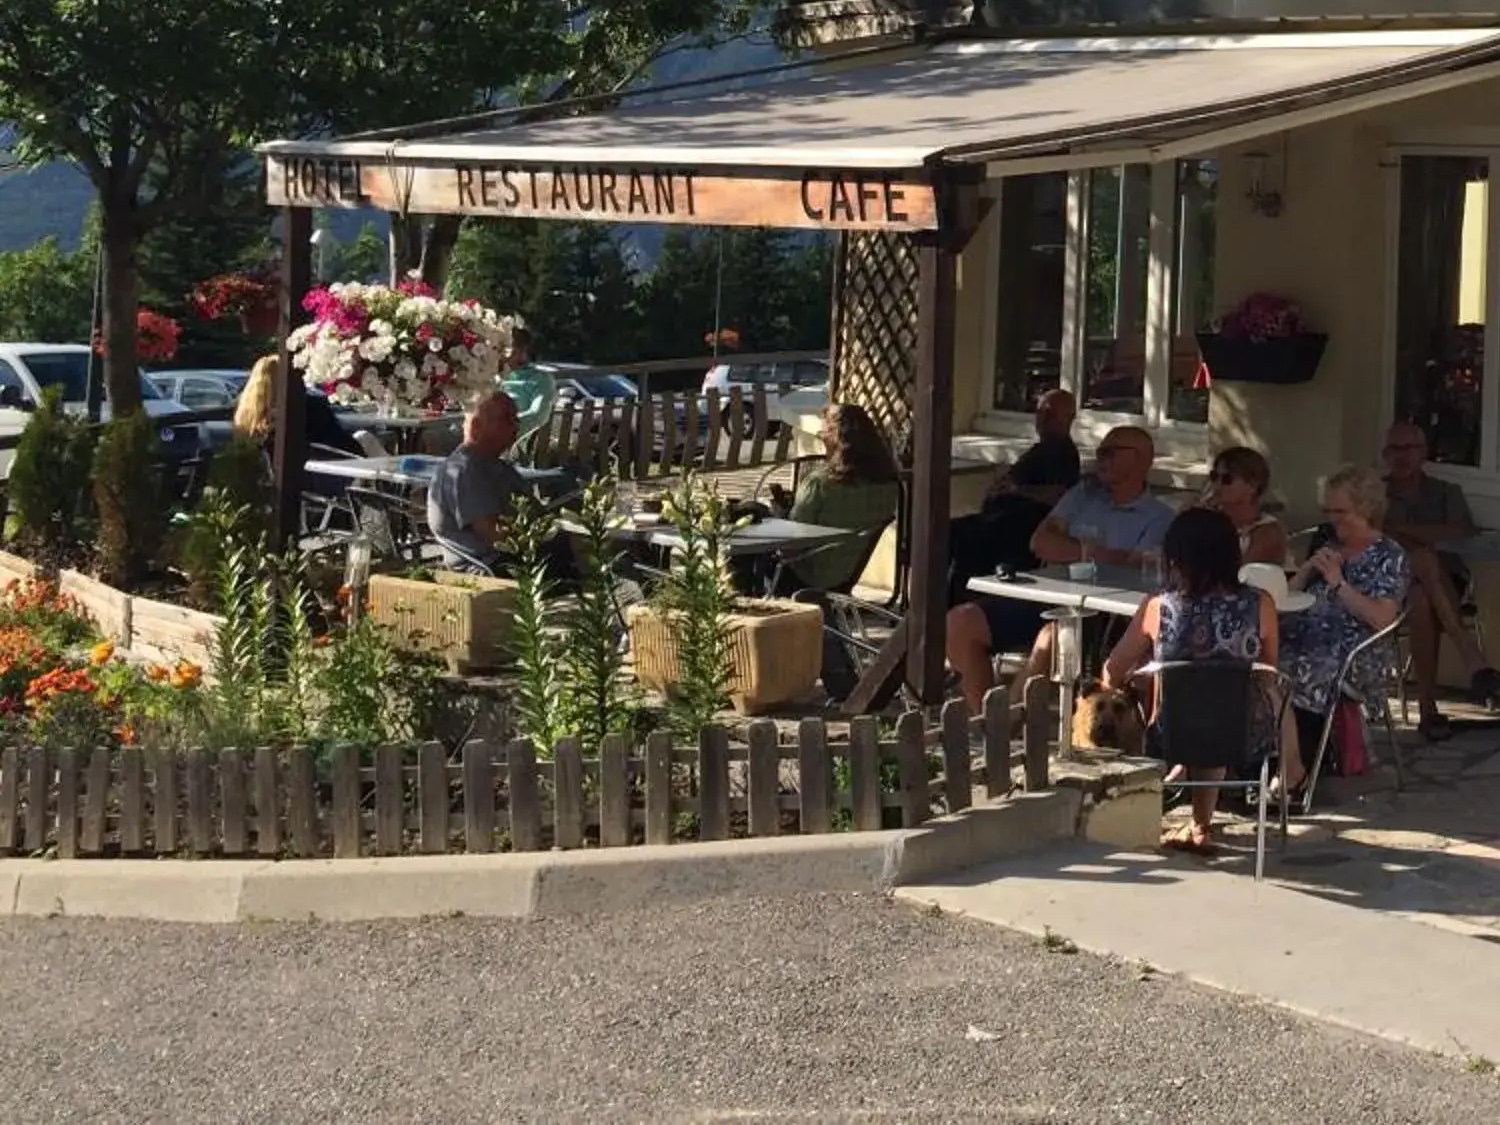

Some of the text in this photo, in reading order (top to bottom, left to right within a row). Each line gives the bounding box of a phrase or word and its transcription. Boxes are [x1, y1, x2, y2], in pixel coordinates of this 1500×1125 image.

[285, 157, 908, 222] HOTEL RESTAURANT CAFE
